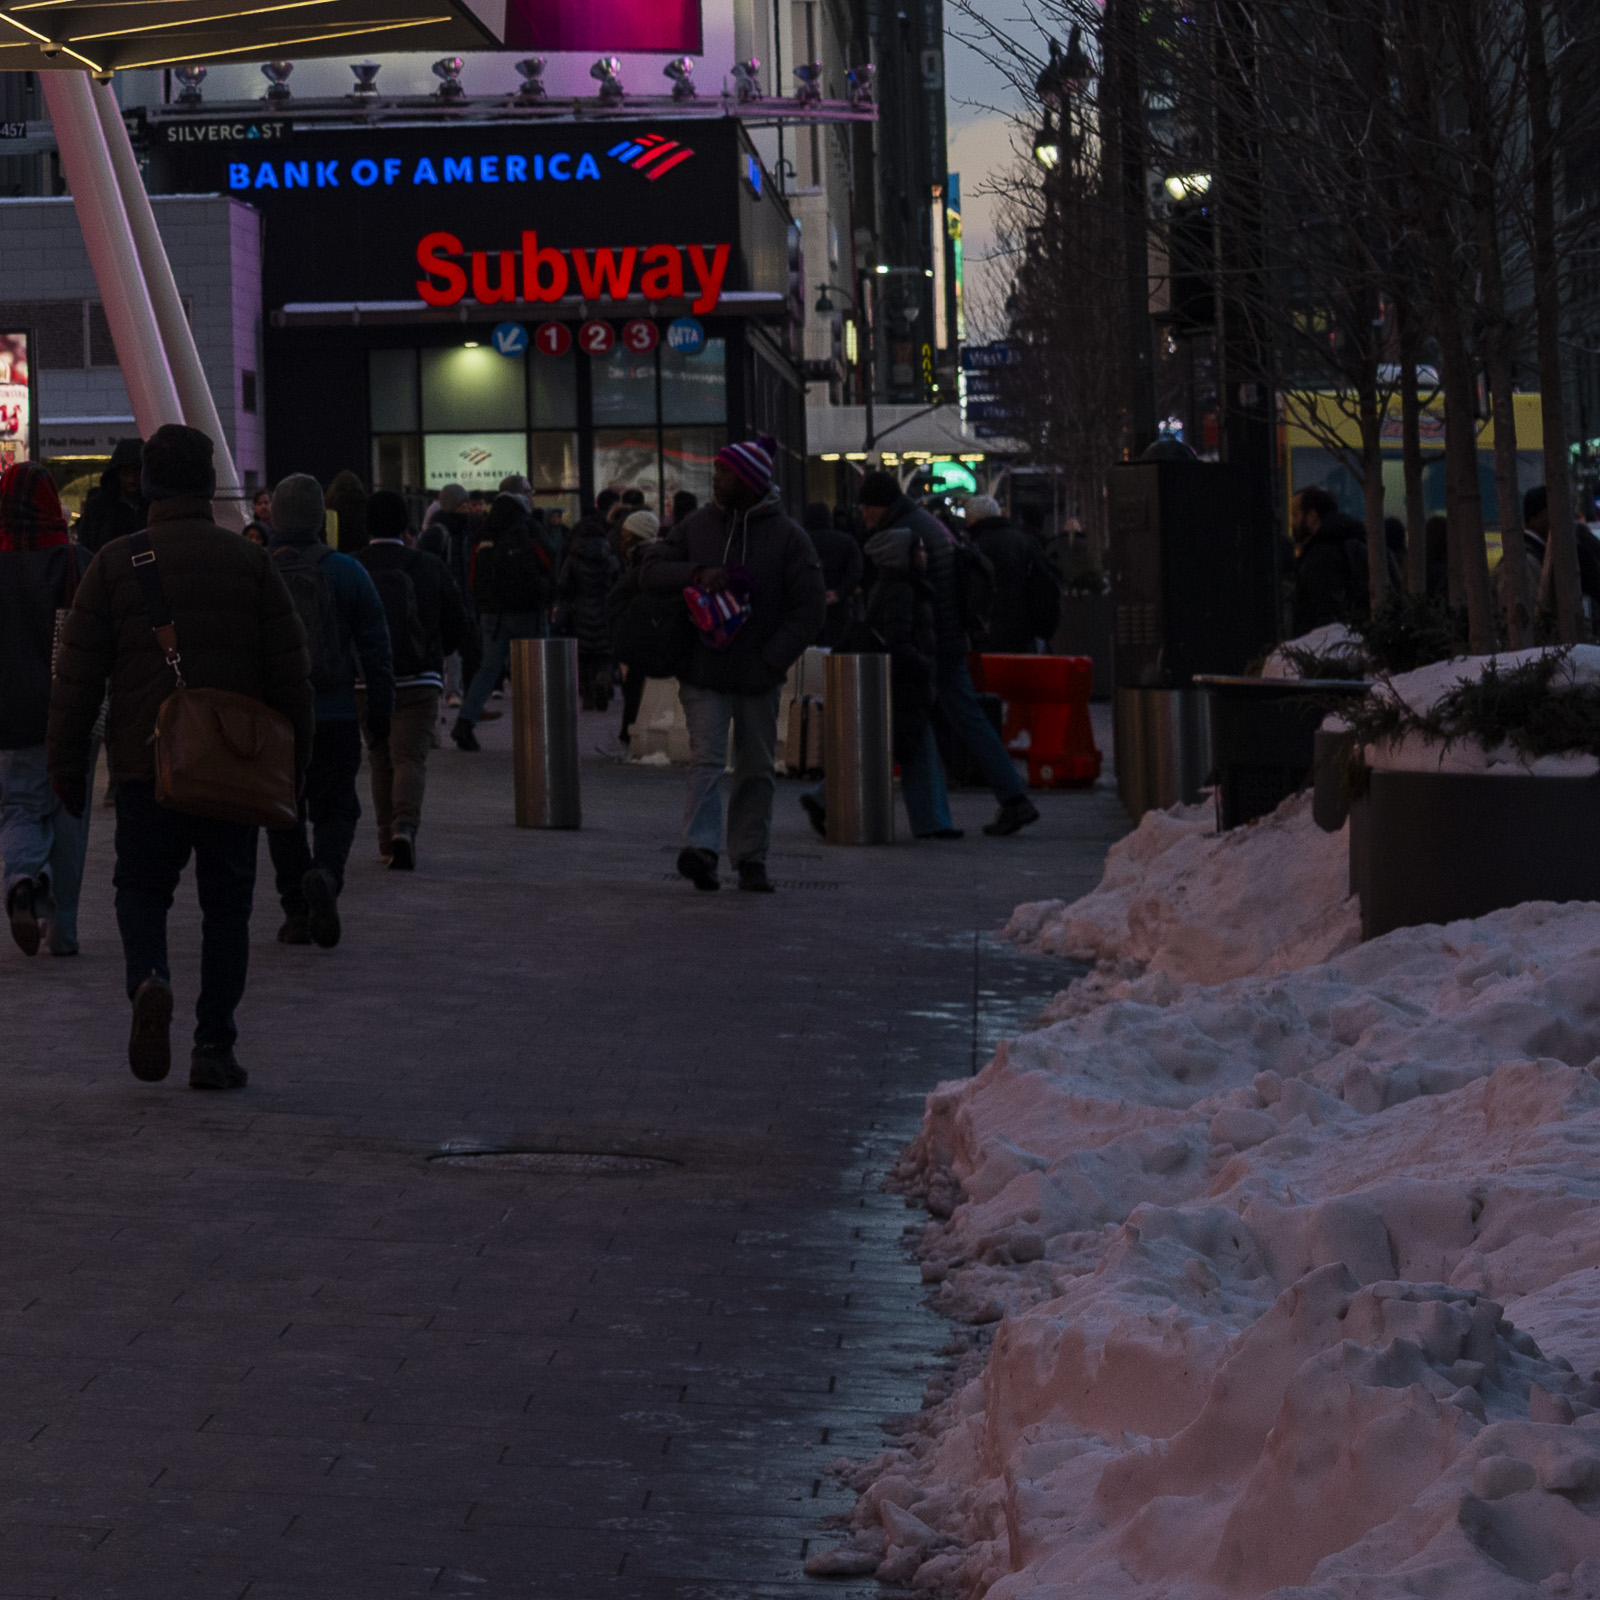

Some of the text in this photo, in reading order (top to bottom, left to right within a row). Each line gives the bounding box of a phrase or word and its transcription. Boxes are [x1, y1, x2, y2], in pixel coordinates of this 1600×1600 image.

[167, 122, 284, 142] SILVERCAST
[229, 152, 600, 190] BANK OF AMERICA
[416, 230, 731, 315] Subway
[588, 326, 606, 350] 2
[631, 324, 650, 349] 3
